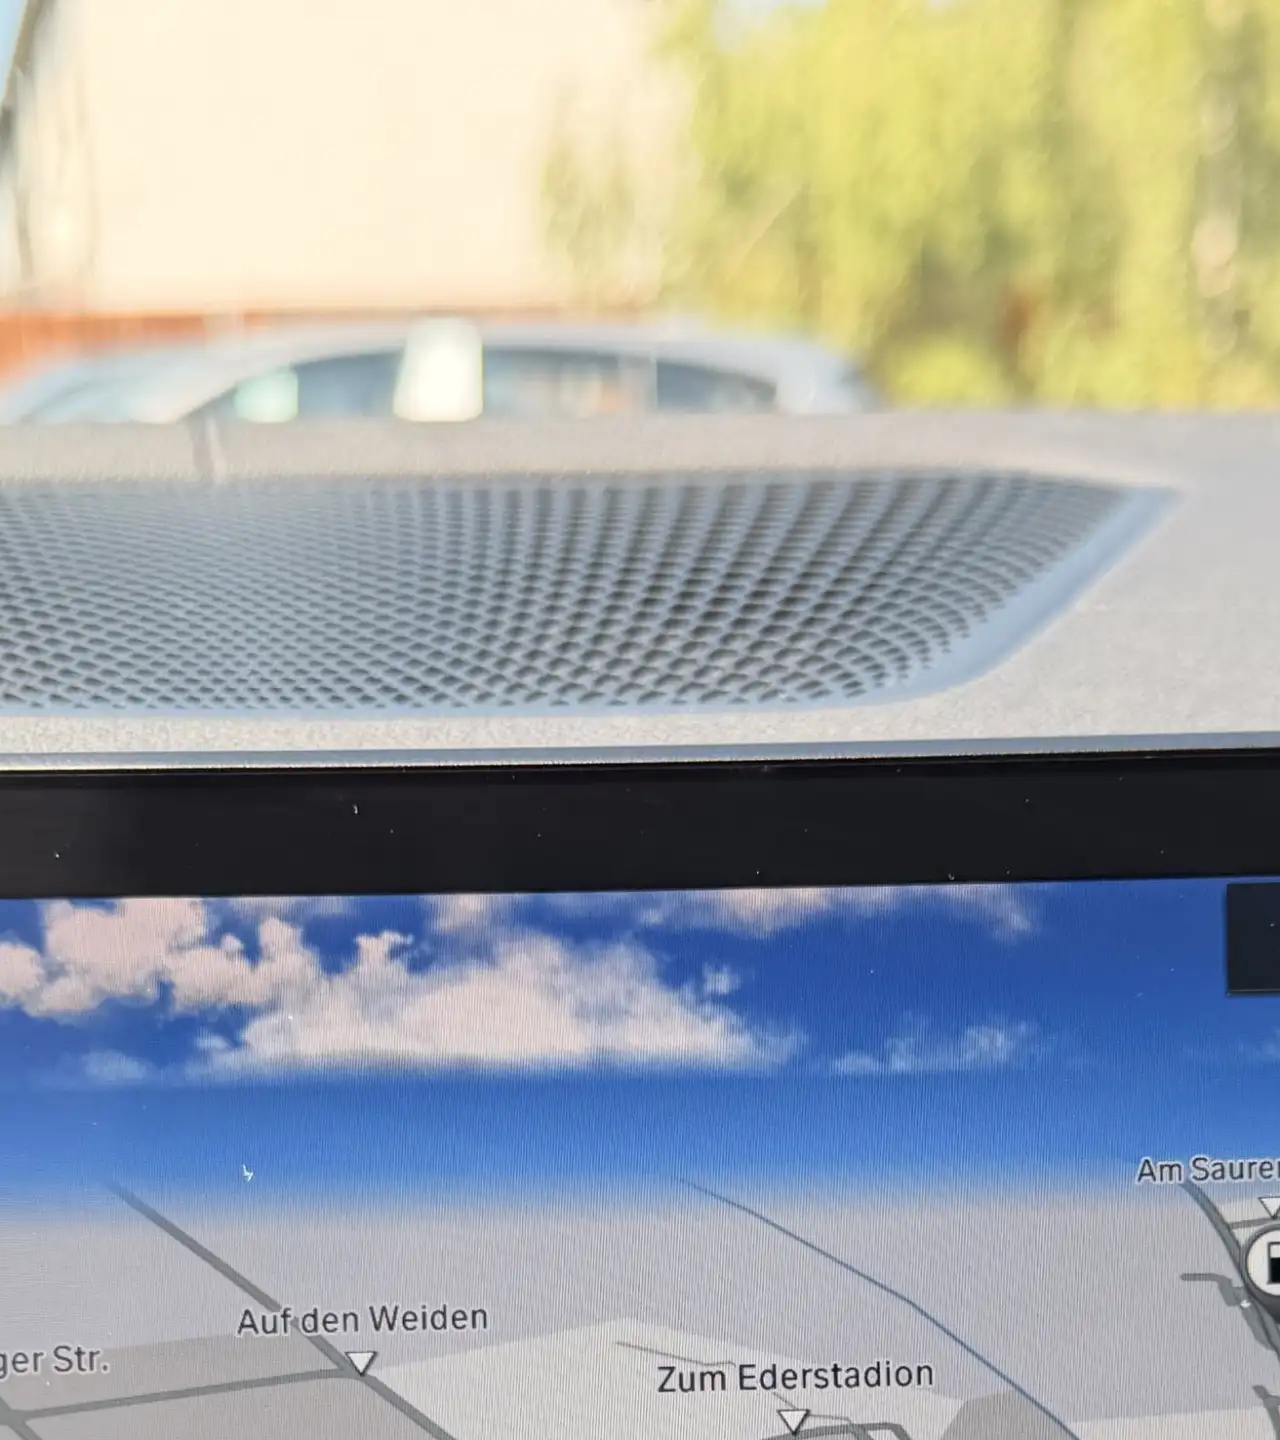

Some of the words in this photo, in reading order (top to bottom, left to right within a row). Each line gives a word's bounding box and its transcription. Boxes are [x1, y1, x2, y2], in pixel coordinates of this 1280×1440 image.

[1137, 1158, 1183, 1183] Am
[237, 1309, 294, 1335] Auf
[301, 1307, 359, 1332] den
[369, 1305, 488, 1331] Weiden
[53, 1346, 110, 1373] Str.
[657, 1366, 726, 1393] Zum
[738, 1360, 934, 1391] Ederstadion
